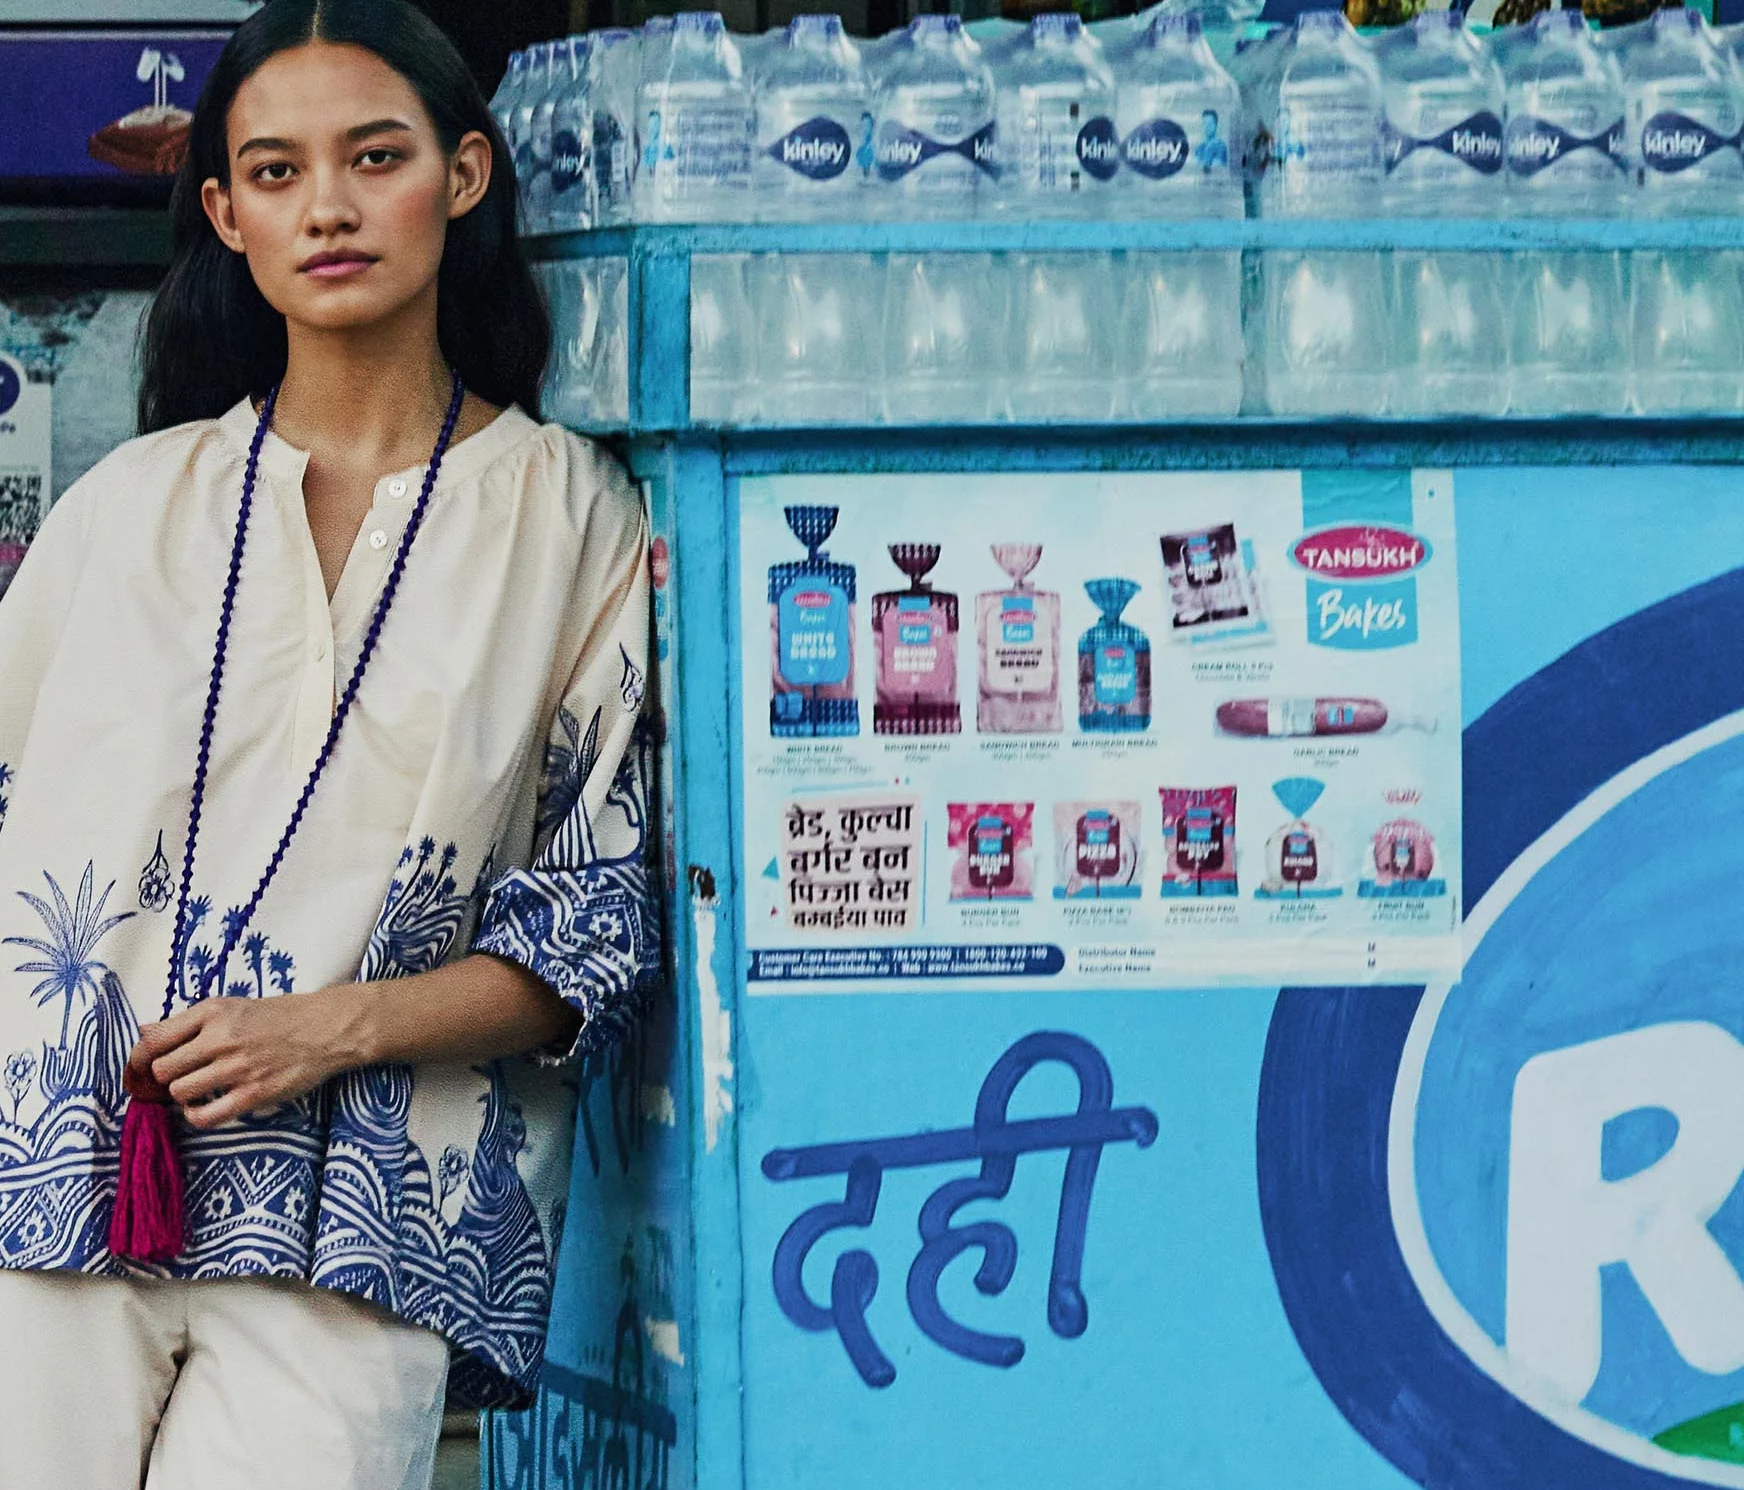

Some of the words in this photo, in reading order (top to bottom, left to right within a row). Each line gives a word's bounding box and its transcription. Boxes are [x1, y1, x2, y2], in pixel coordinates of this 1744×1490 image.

[783, 137, 845, 164] kinley
[1127, 136, 1182, 164] kinley
[1644, 130, 1706, 158] kinley
[1304, 542, 1419, 570] TANSUKH
[1318, 589, 1406, 640] Bakes
[760, 1028, 1159, 1391] दही
